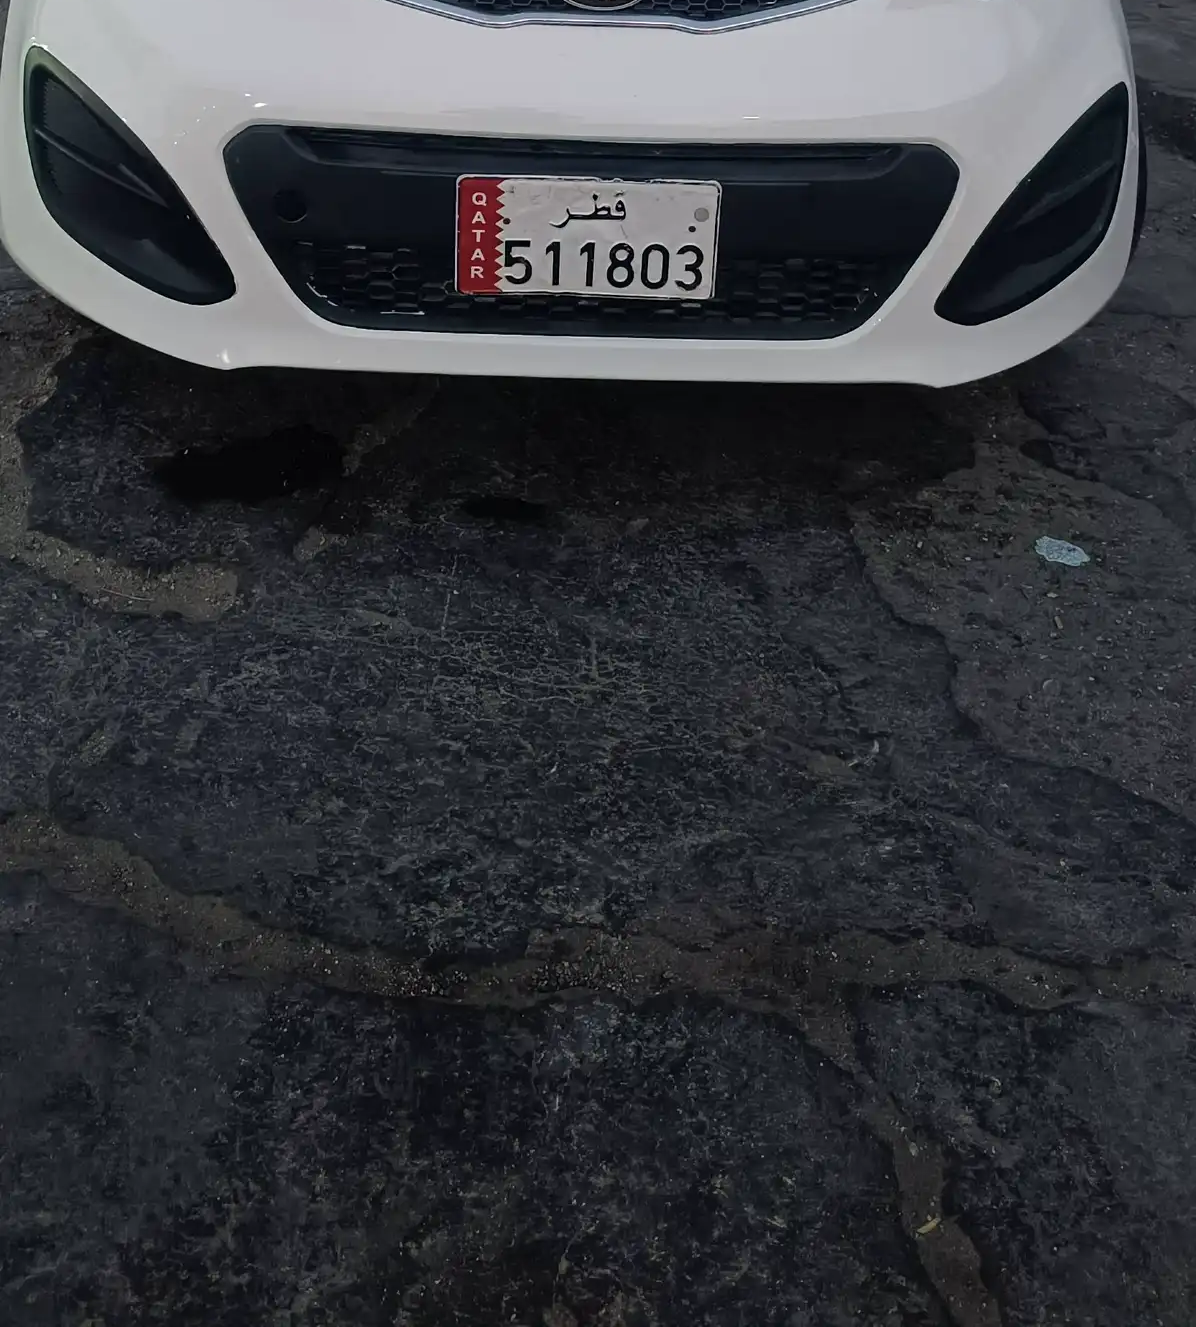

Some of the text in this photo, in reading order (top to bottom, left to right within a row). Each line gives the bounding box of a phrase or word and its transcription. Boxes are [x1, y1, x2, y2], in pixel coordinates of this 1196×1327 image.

[470, 191, 487, 279] QATAR
[549, 190, 627, 229] قطر
[503, 239, 704, 291] 511803
